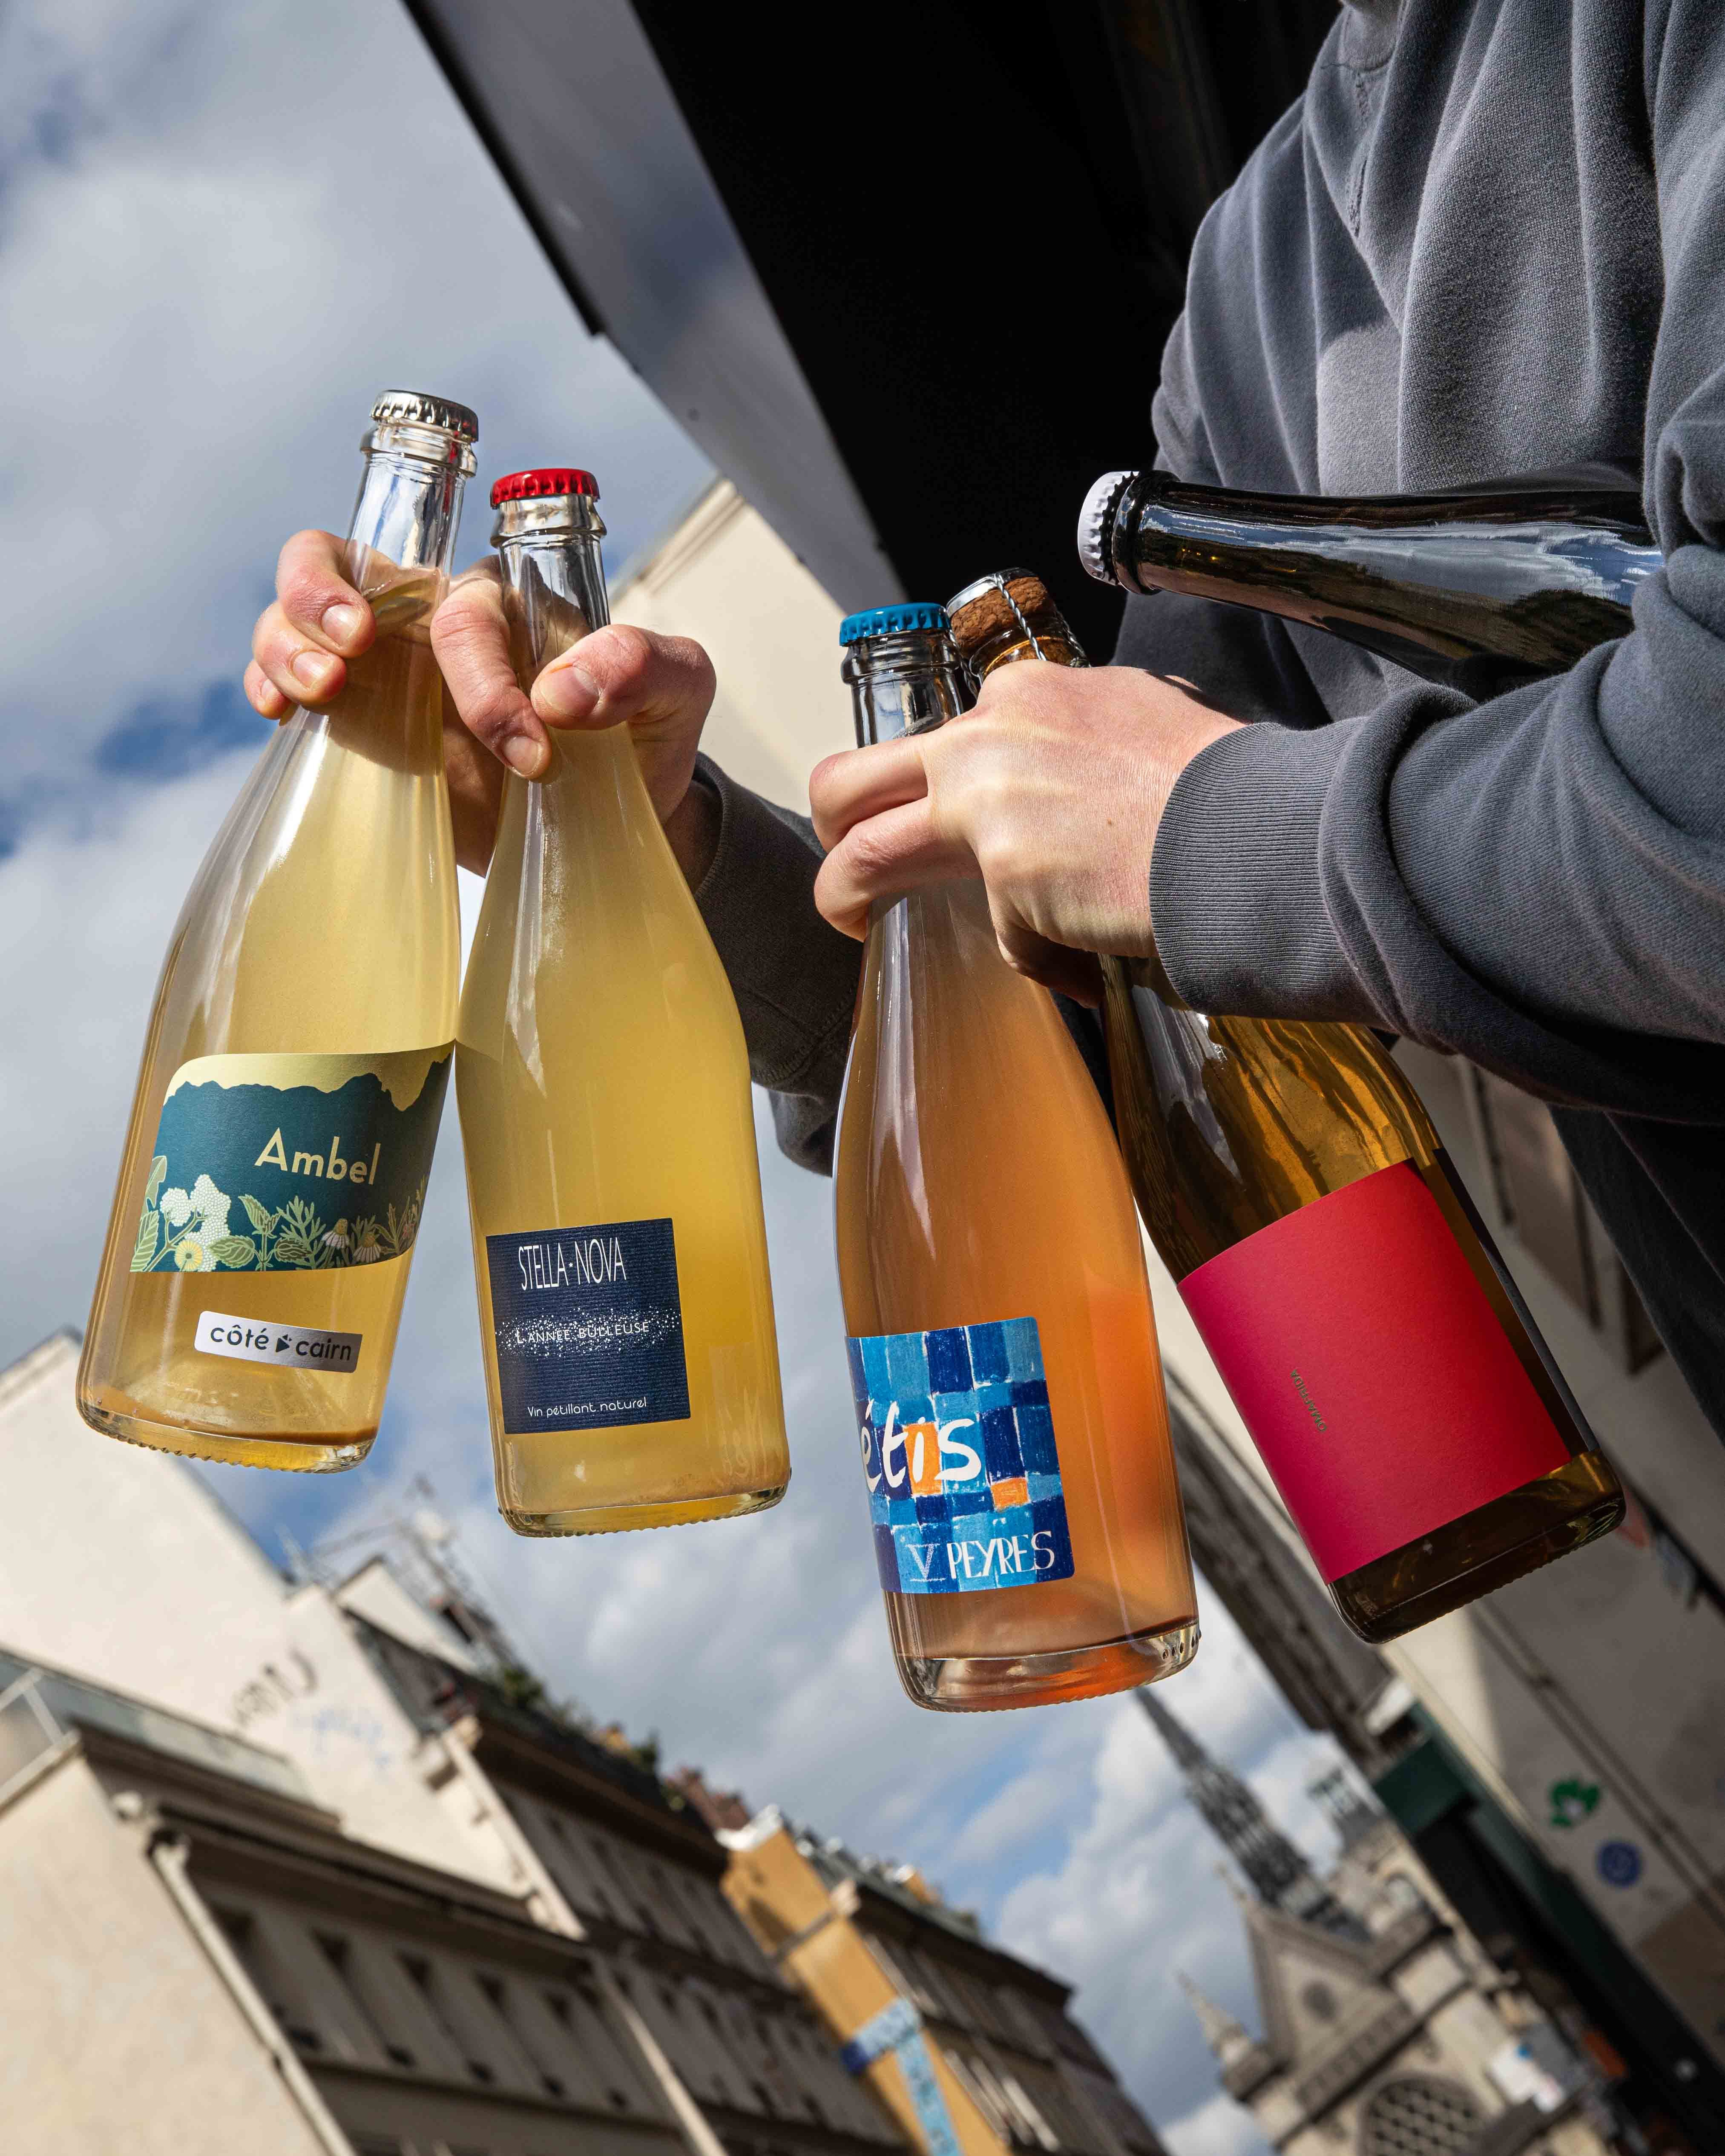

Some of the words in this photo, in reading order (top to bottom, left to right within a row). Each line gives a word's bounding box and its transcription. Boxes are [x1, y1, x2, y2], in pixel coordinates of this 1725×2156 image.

[254, 1127, 381, 1185] Ambel
[518, 1242, 569, 1291] STELLA
[575, 1237, 627, 1283] NOVA
[210, 1324, 269, 1350] côté
[296, 1338, 351, 1361] cairn
[578, 1321, 650, 1339] BULLEUSE
[527, 1406, 543, 1417] Vin
[546, 1403, 596, 1418] pétillant
[600, 1396, 647, 1411] naturel
